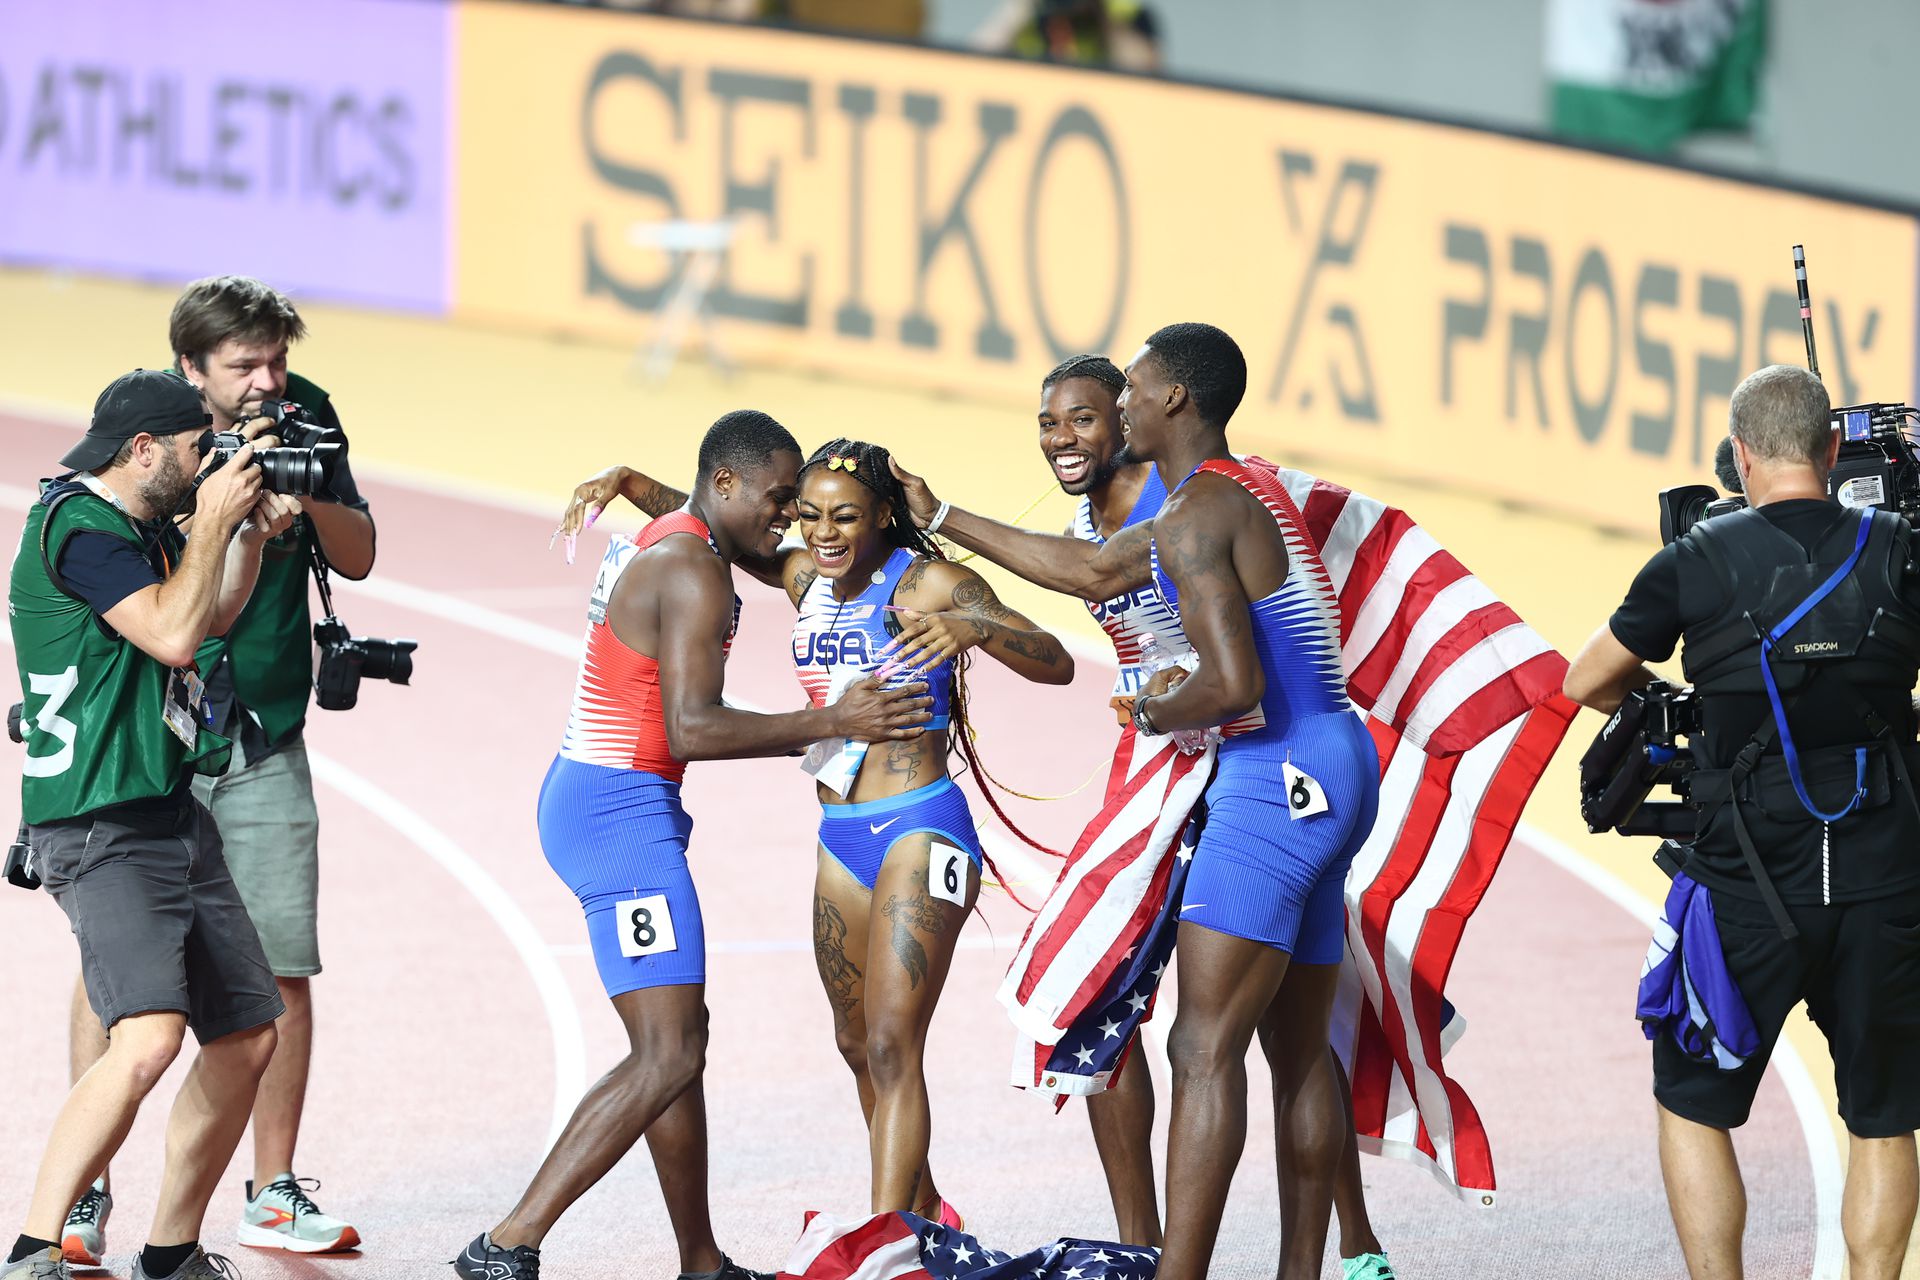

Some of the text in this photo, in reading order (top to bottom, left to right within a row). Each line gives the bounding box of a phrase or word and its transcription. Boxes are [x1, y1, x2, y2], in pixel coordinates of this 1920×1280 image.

[20, 58, 418, 212] ATHLETICS
[581, 51, 1131, 366] SEIKO
[792, 631, 869, 666] USA
[1794, 641, 1838, 654] STEADICAM
[1603, 707, 1622, 741] PRO
[1290, 775, 1311, 810] 6
[944, 855, 958, 894] 6
[631, 907, 657, 947] 8
